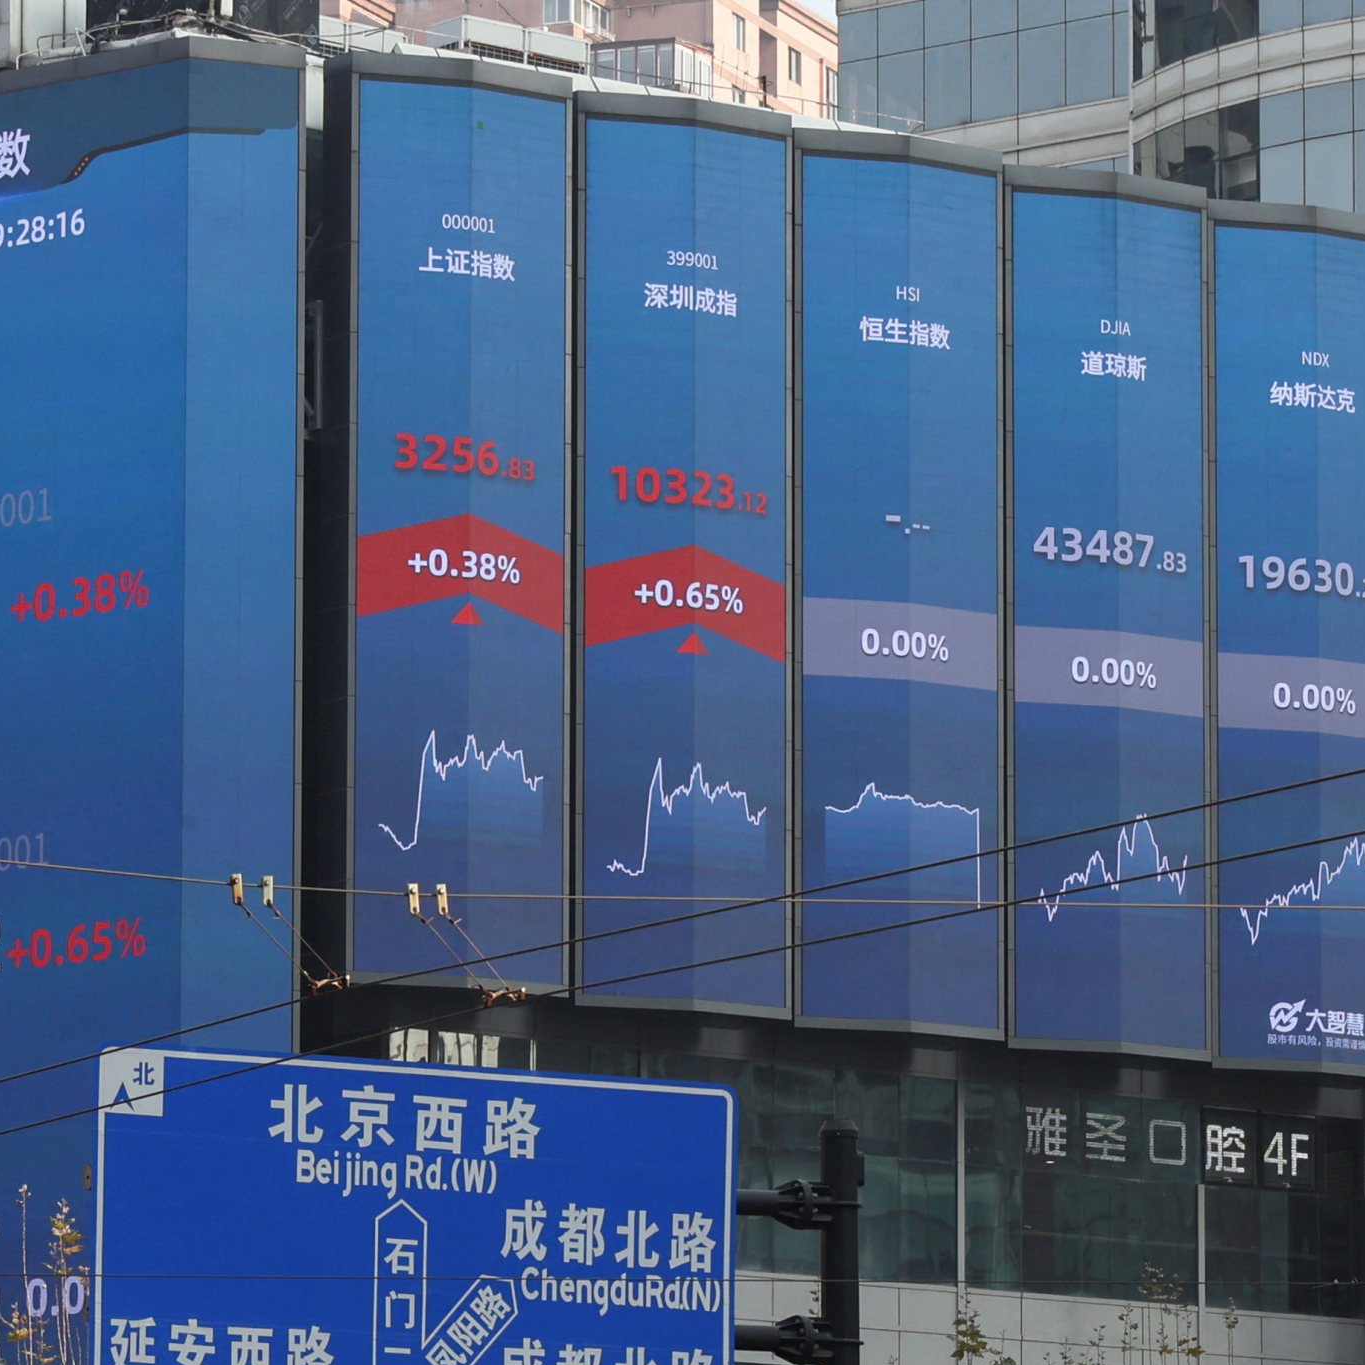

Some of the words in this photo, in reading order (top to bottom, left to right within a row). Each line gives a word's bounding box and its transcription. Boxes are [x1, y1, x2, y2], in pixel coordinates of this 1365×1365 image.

[441, 213, 496, 234] 000001
[418, 246, 516, 283] 上证指数
[666, 249, 719, 271] 399001
[643, 282, 738, 318] 深圳成指
[895, 286, 921, 302] HSI
[859, 316, 951, 351] 恒生指数
[1100, 319, 1132, 337] DJIA
[1080, 350, 1148, 382] 道琼斯
[1300, 350, 1331, 368] NDX
[1269, 381, 1356, 414] 纳斯达克
[393, 433, 536, 482] 3256.83
[610, 466, 769, 515] 10323.12
[407, 548, 521, 585] +0.38%
[1033, 526, 1188, 574] 43487.83
[10, 569, 150, 622] +0.38%
[634, 579, 744, 615] +0.65%
[860, 627, 950, 663] 0.00%
[1070, 655, 1157, 690] 0.00%
[1272, 681, 1357, 715] 0.00%
[6, 917, 146, 969] +0.65%
[1305, 1008, 1365, 1037] 大智慧
[132, 1061, 155, 1086] 北
[268, 1083, 542, 1160] 北京西路
[296, 1148, 398, 1198] Beijing
[500, 1199, 717, 1273] 成都北路
